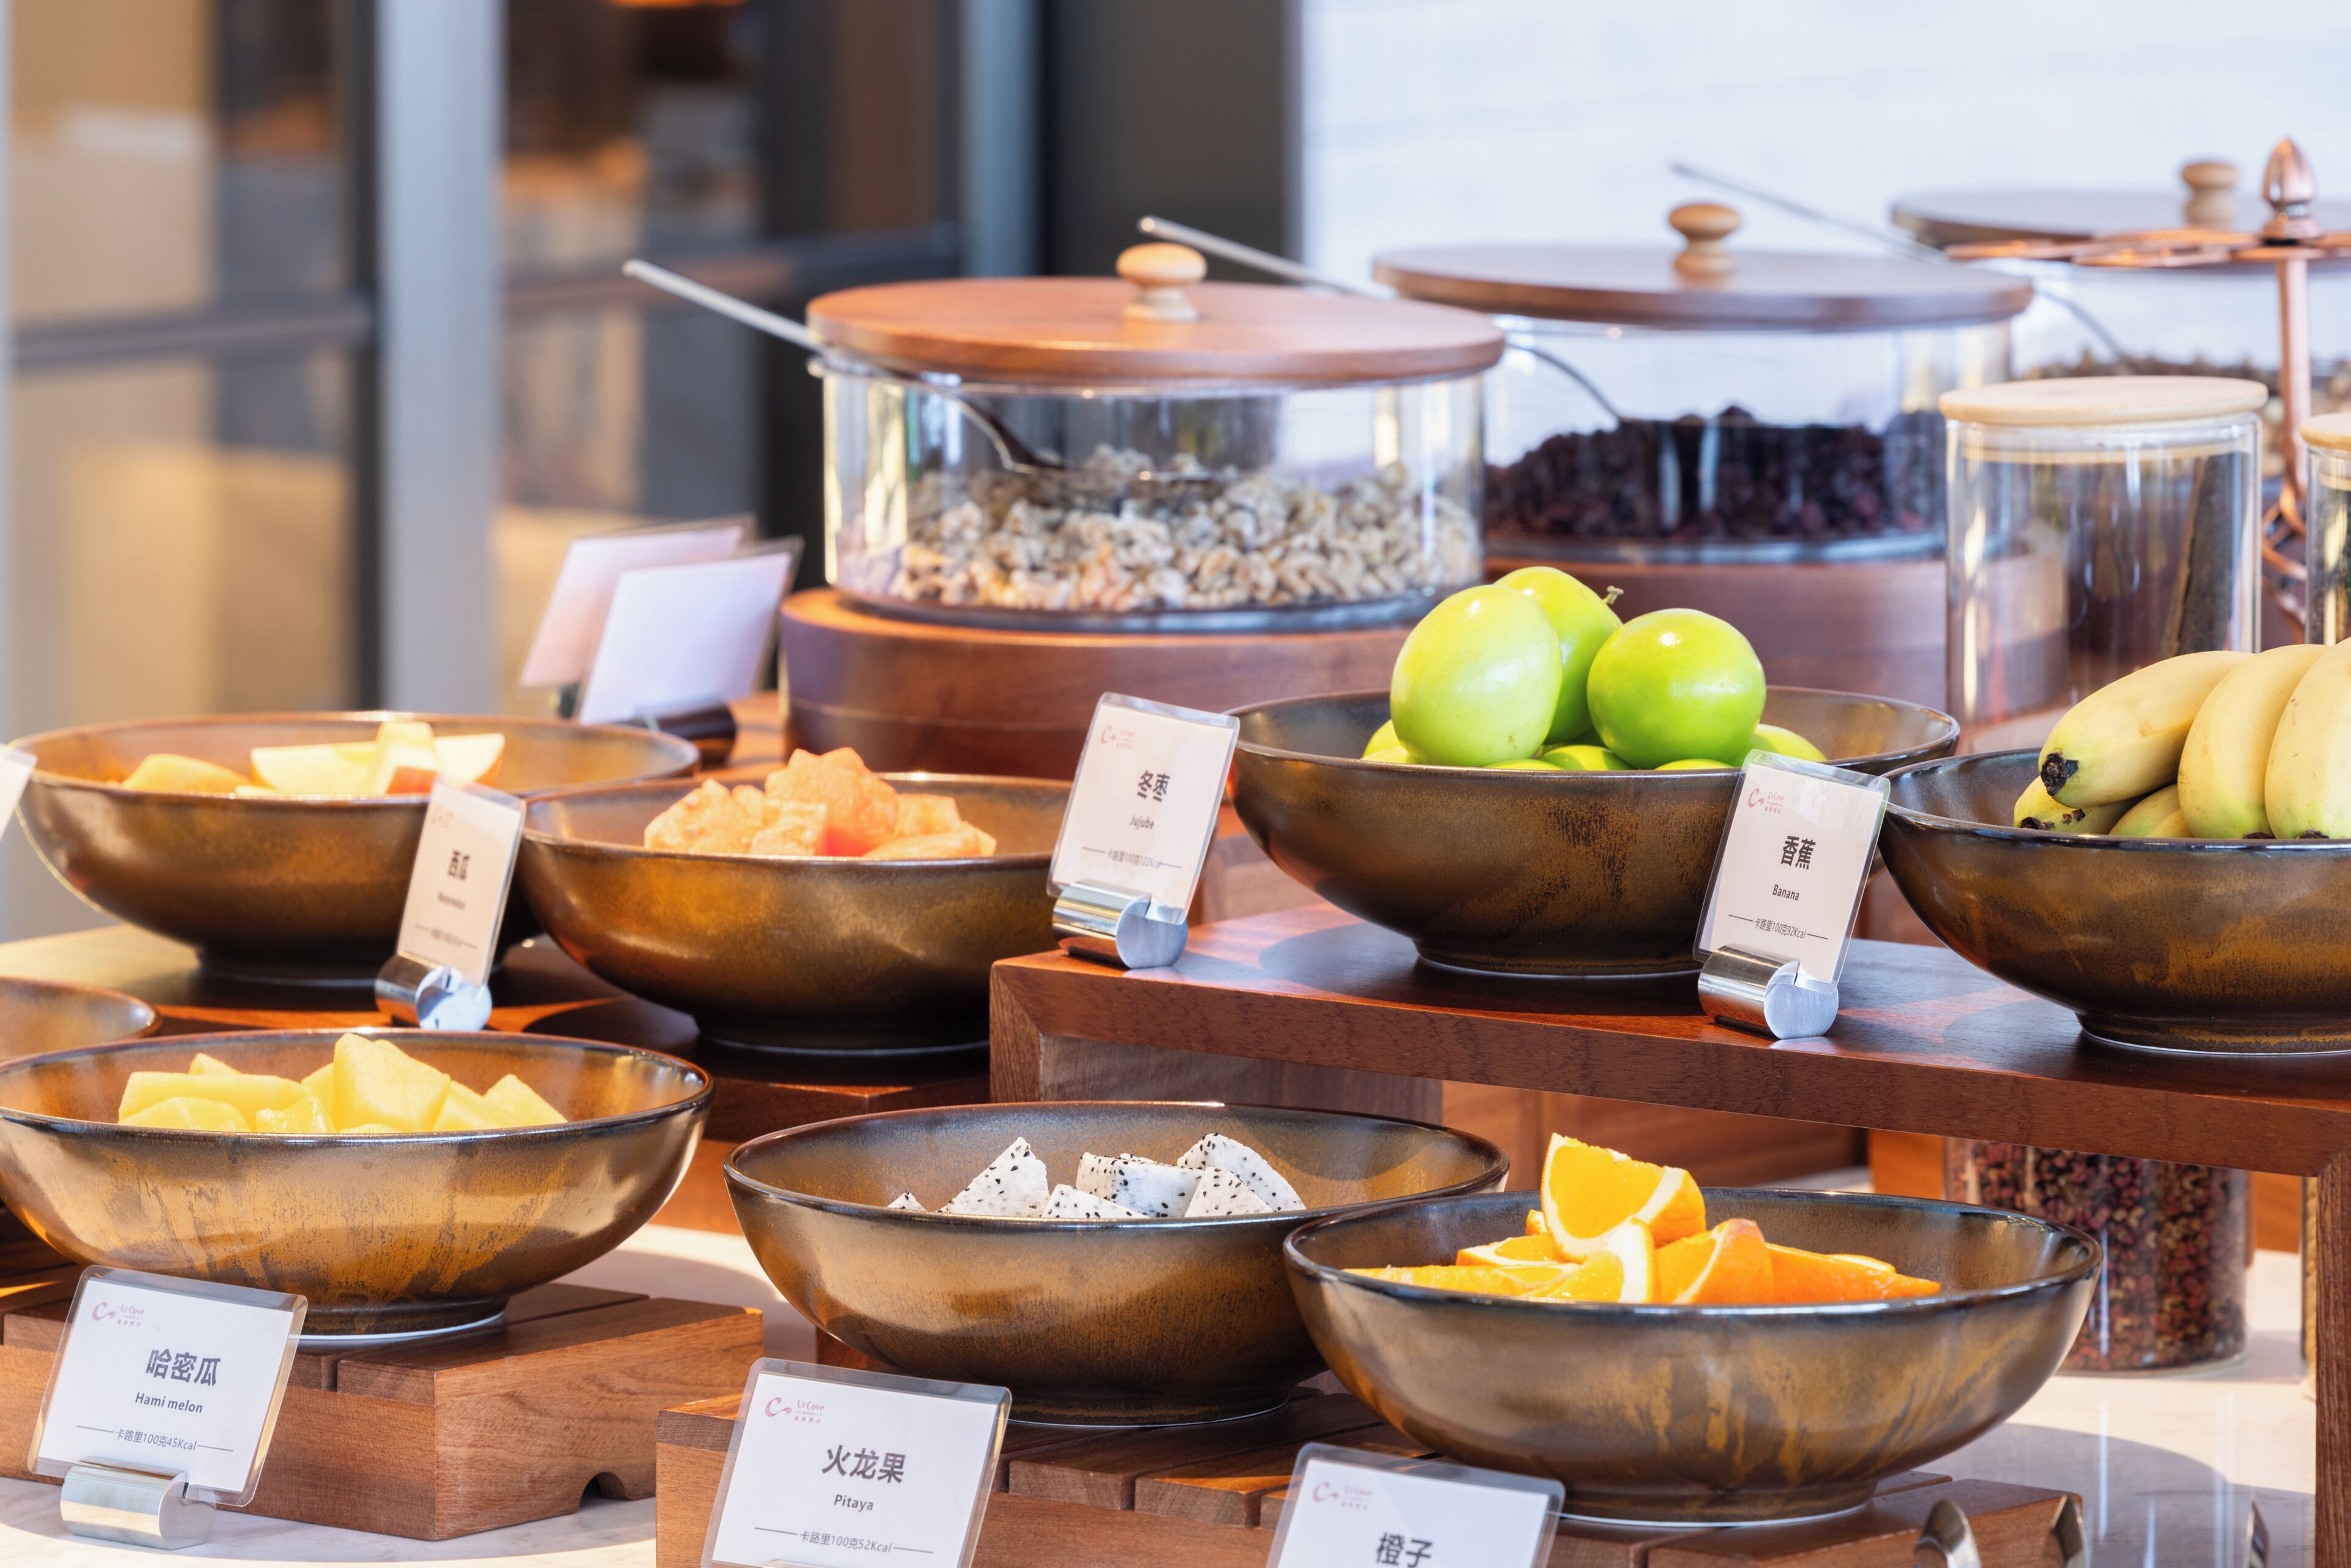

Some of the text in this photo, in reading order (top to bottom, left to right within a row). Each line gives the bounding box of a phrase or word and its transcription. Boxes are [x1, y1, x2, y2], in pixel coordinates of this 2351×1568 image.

[1137, 770, 1171, 803] 冬枣
[1130, 815, 1154, 830] Jujube
[1780, 835, 1816, 870] 香蕉
[1772, 884, 1800, 901] Banana
[1755, 918, 1806, 939] 卡路里100克92Kcal
[146, 1349, 221, 1387] 哈密瓜
[135, 1392, 203, 1414] Hami melon
[797, 1400, 824, 1411] UrCove
[116, 1428, 197, 1450] 卡路里100克45Kcal
[822, 1445, 906, 1484] 火龙果
[834, 1495, 874, 1512] Pitaya
[800, 1531, 892, 1553] 卡路里100克52Kcal
[1376, 1532, 1434, 1568] 橙子
